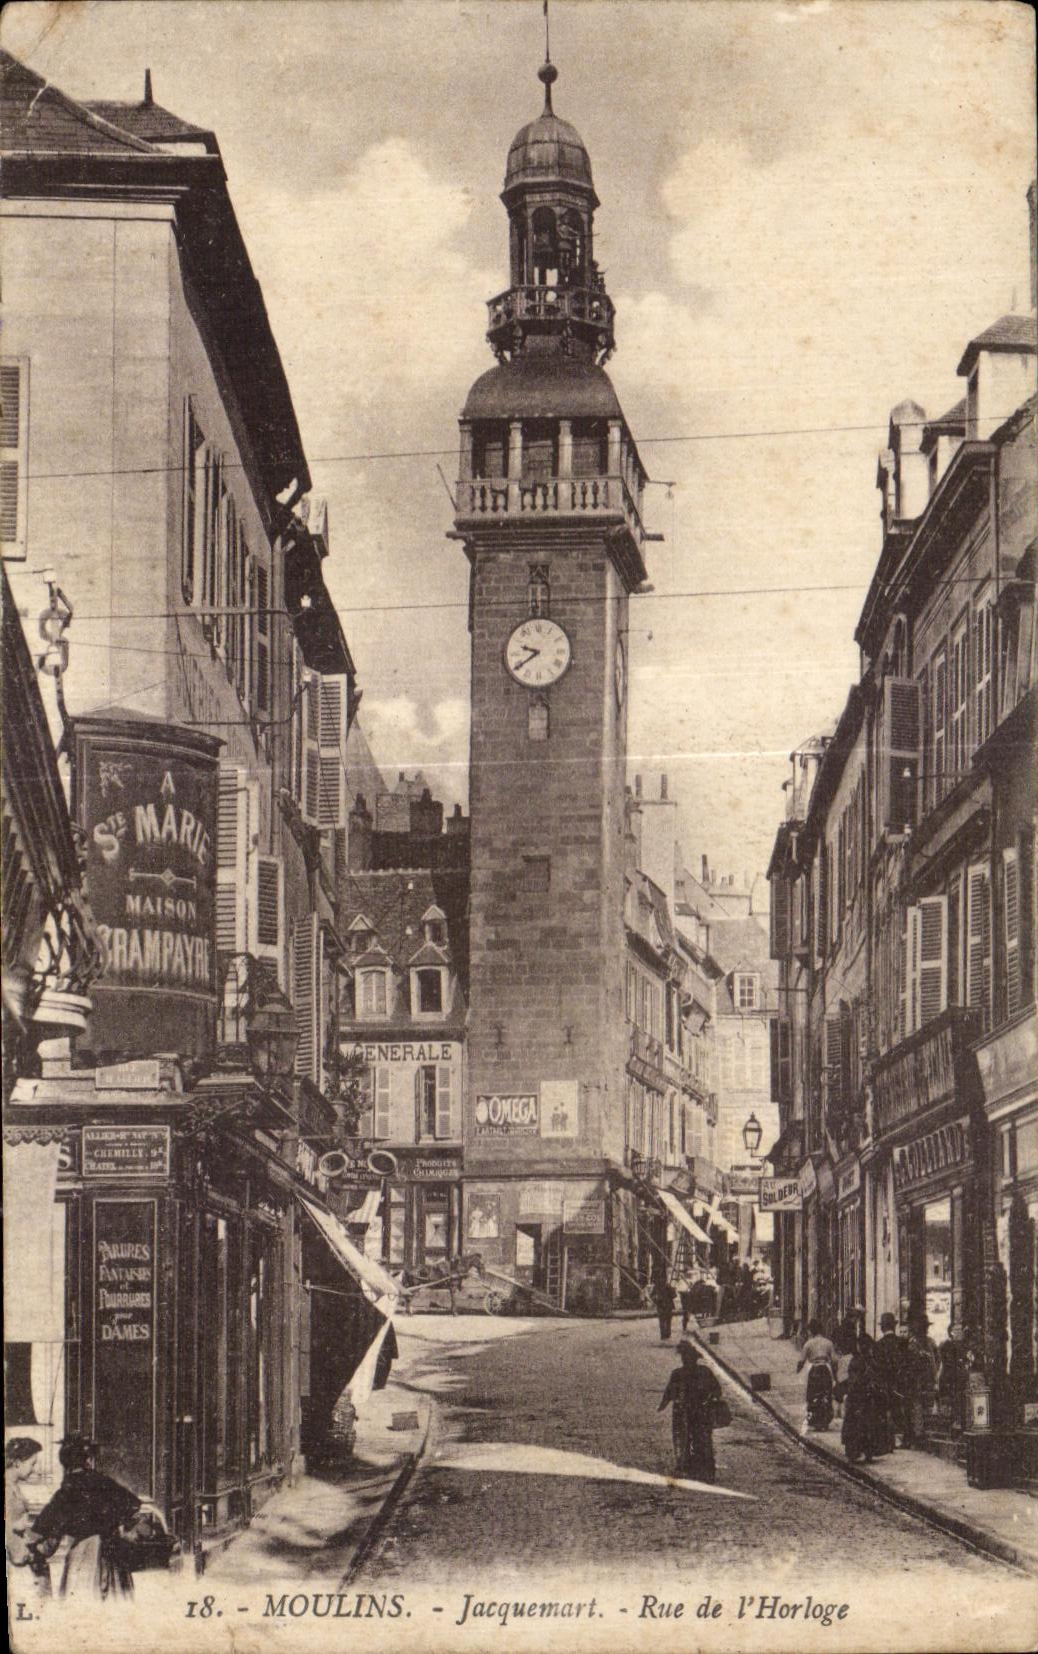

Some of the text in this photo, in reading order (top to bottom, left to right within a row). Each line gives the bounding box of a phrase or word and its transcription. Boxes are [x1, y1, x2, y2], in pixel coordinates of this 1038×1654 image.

[160, 771, 176, 794] A
[134, 803, 211, 865] MARIE
[126, 894, 197, 920] MAISON
[489, 1096, 537, 1125] OMEGA
[762, 1182, 799, 1207] SOLDEUR
[99, 1240, 151, 1262] PARURES
[102, 1324, 150, 1341] DAMES
